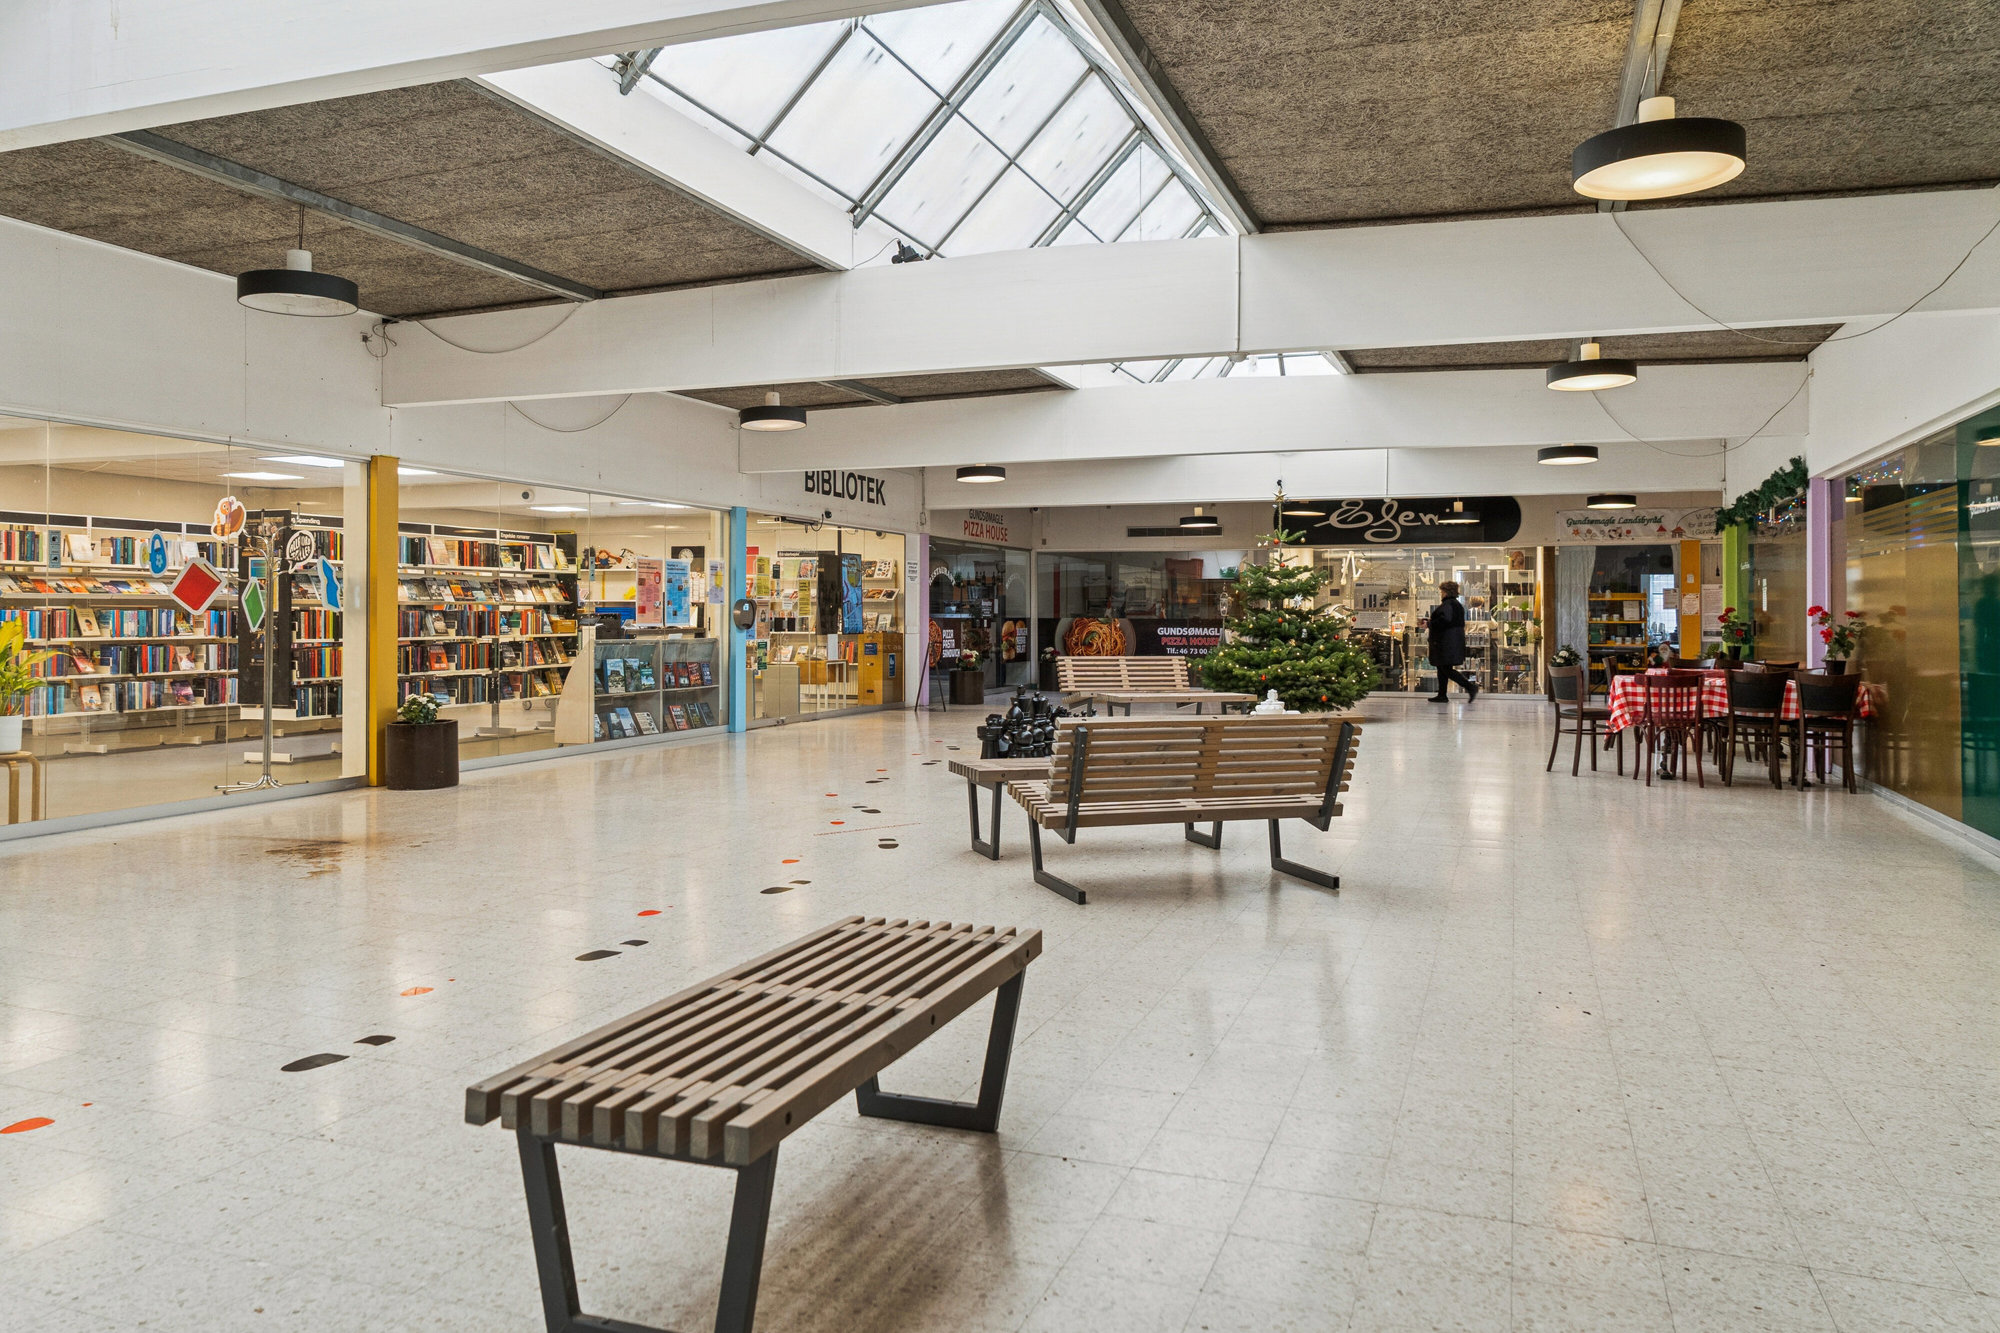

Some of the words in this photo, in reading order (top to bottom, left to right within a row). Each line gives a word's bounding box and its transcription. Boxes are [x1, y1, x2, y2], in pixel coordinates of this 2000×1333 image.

[805, 470, 886, 506] BIBLIOTEK
[963, 520, 985, 538] PIZZA
[985, 523, 1008, 542] HOUSE
[1161, 637, 1188, 646] PIZZA
